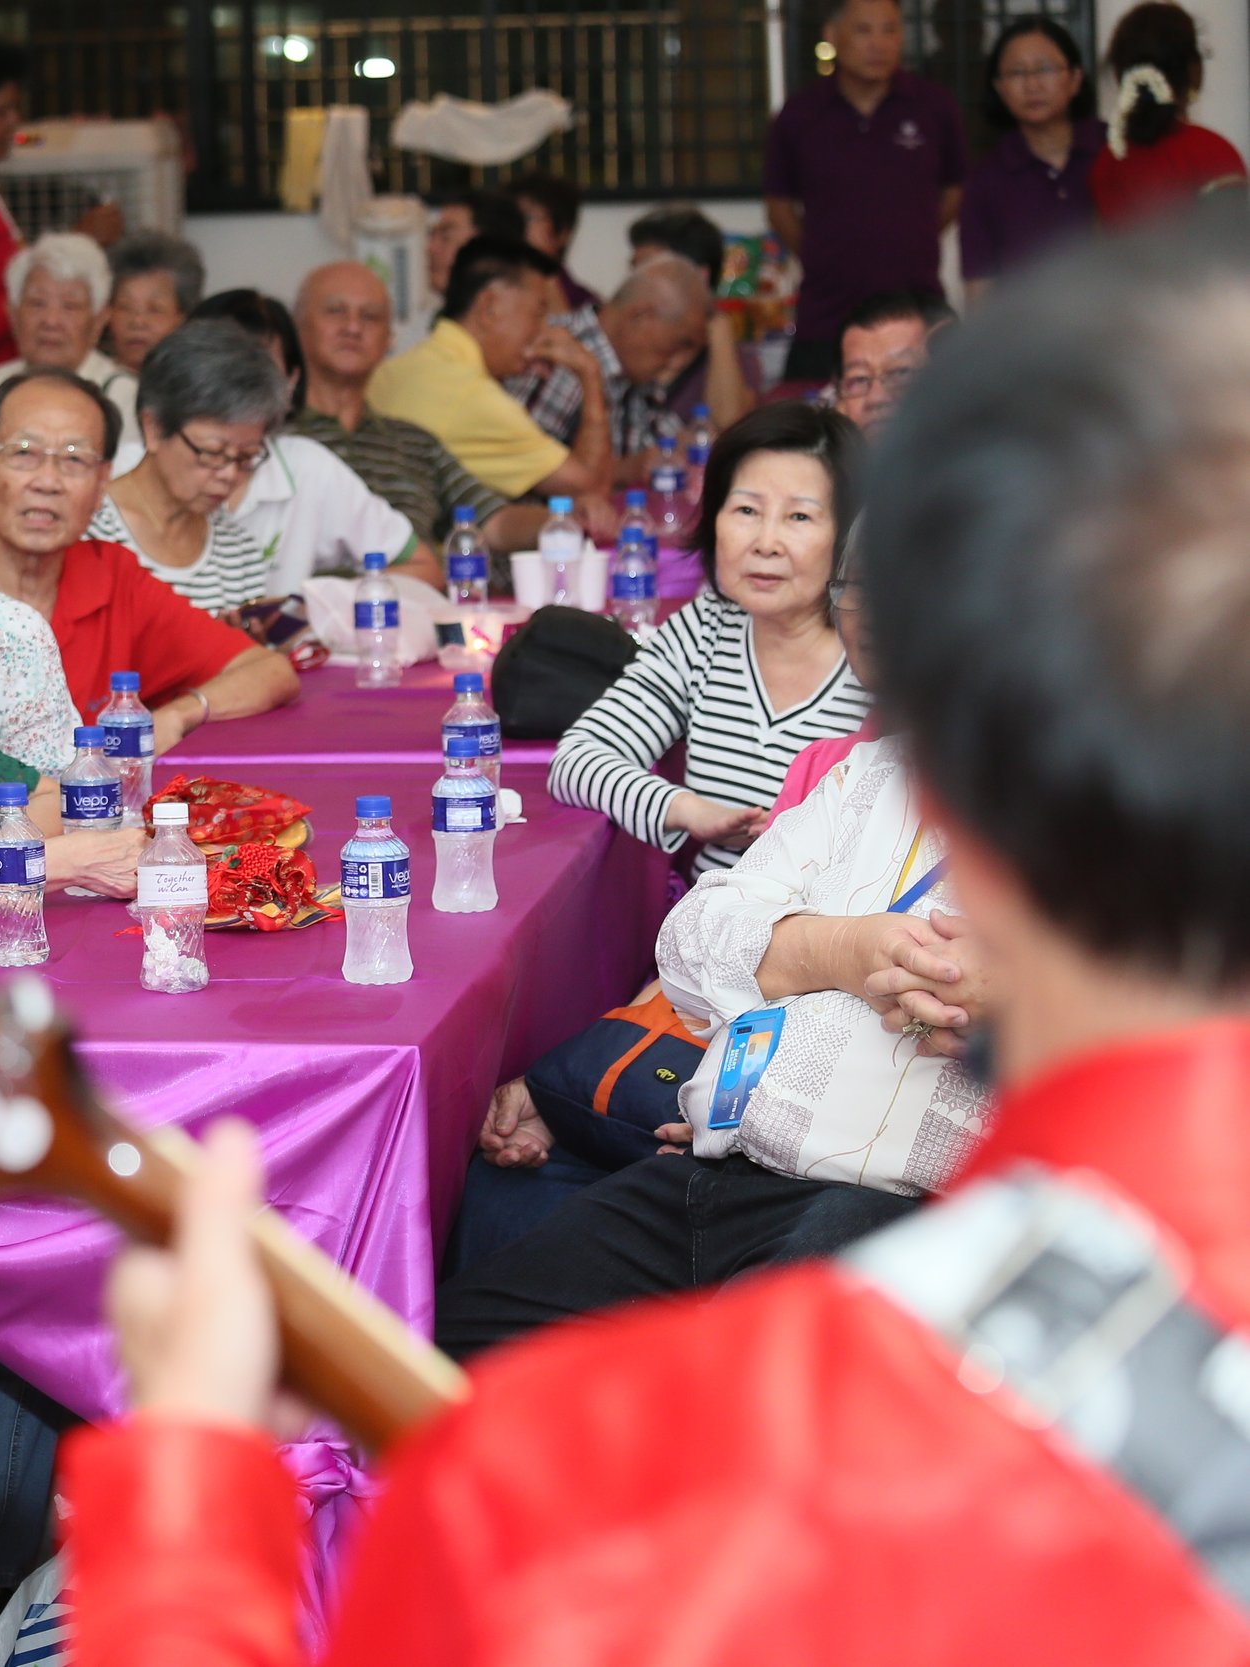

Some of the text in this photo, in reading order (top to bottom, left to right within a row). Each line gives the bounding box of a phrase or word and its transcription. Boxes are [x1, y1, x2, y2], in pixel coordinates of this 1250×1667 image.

[73, 796, 109, 808] vepo
[155, 870, 195, 890] Together
[388, 870, 410, 884] vep
[170, 883, 189, 893] Can
